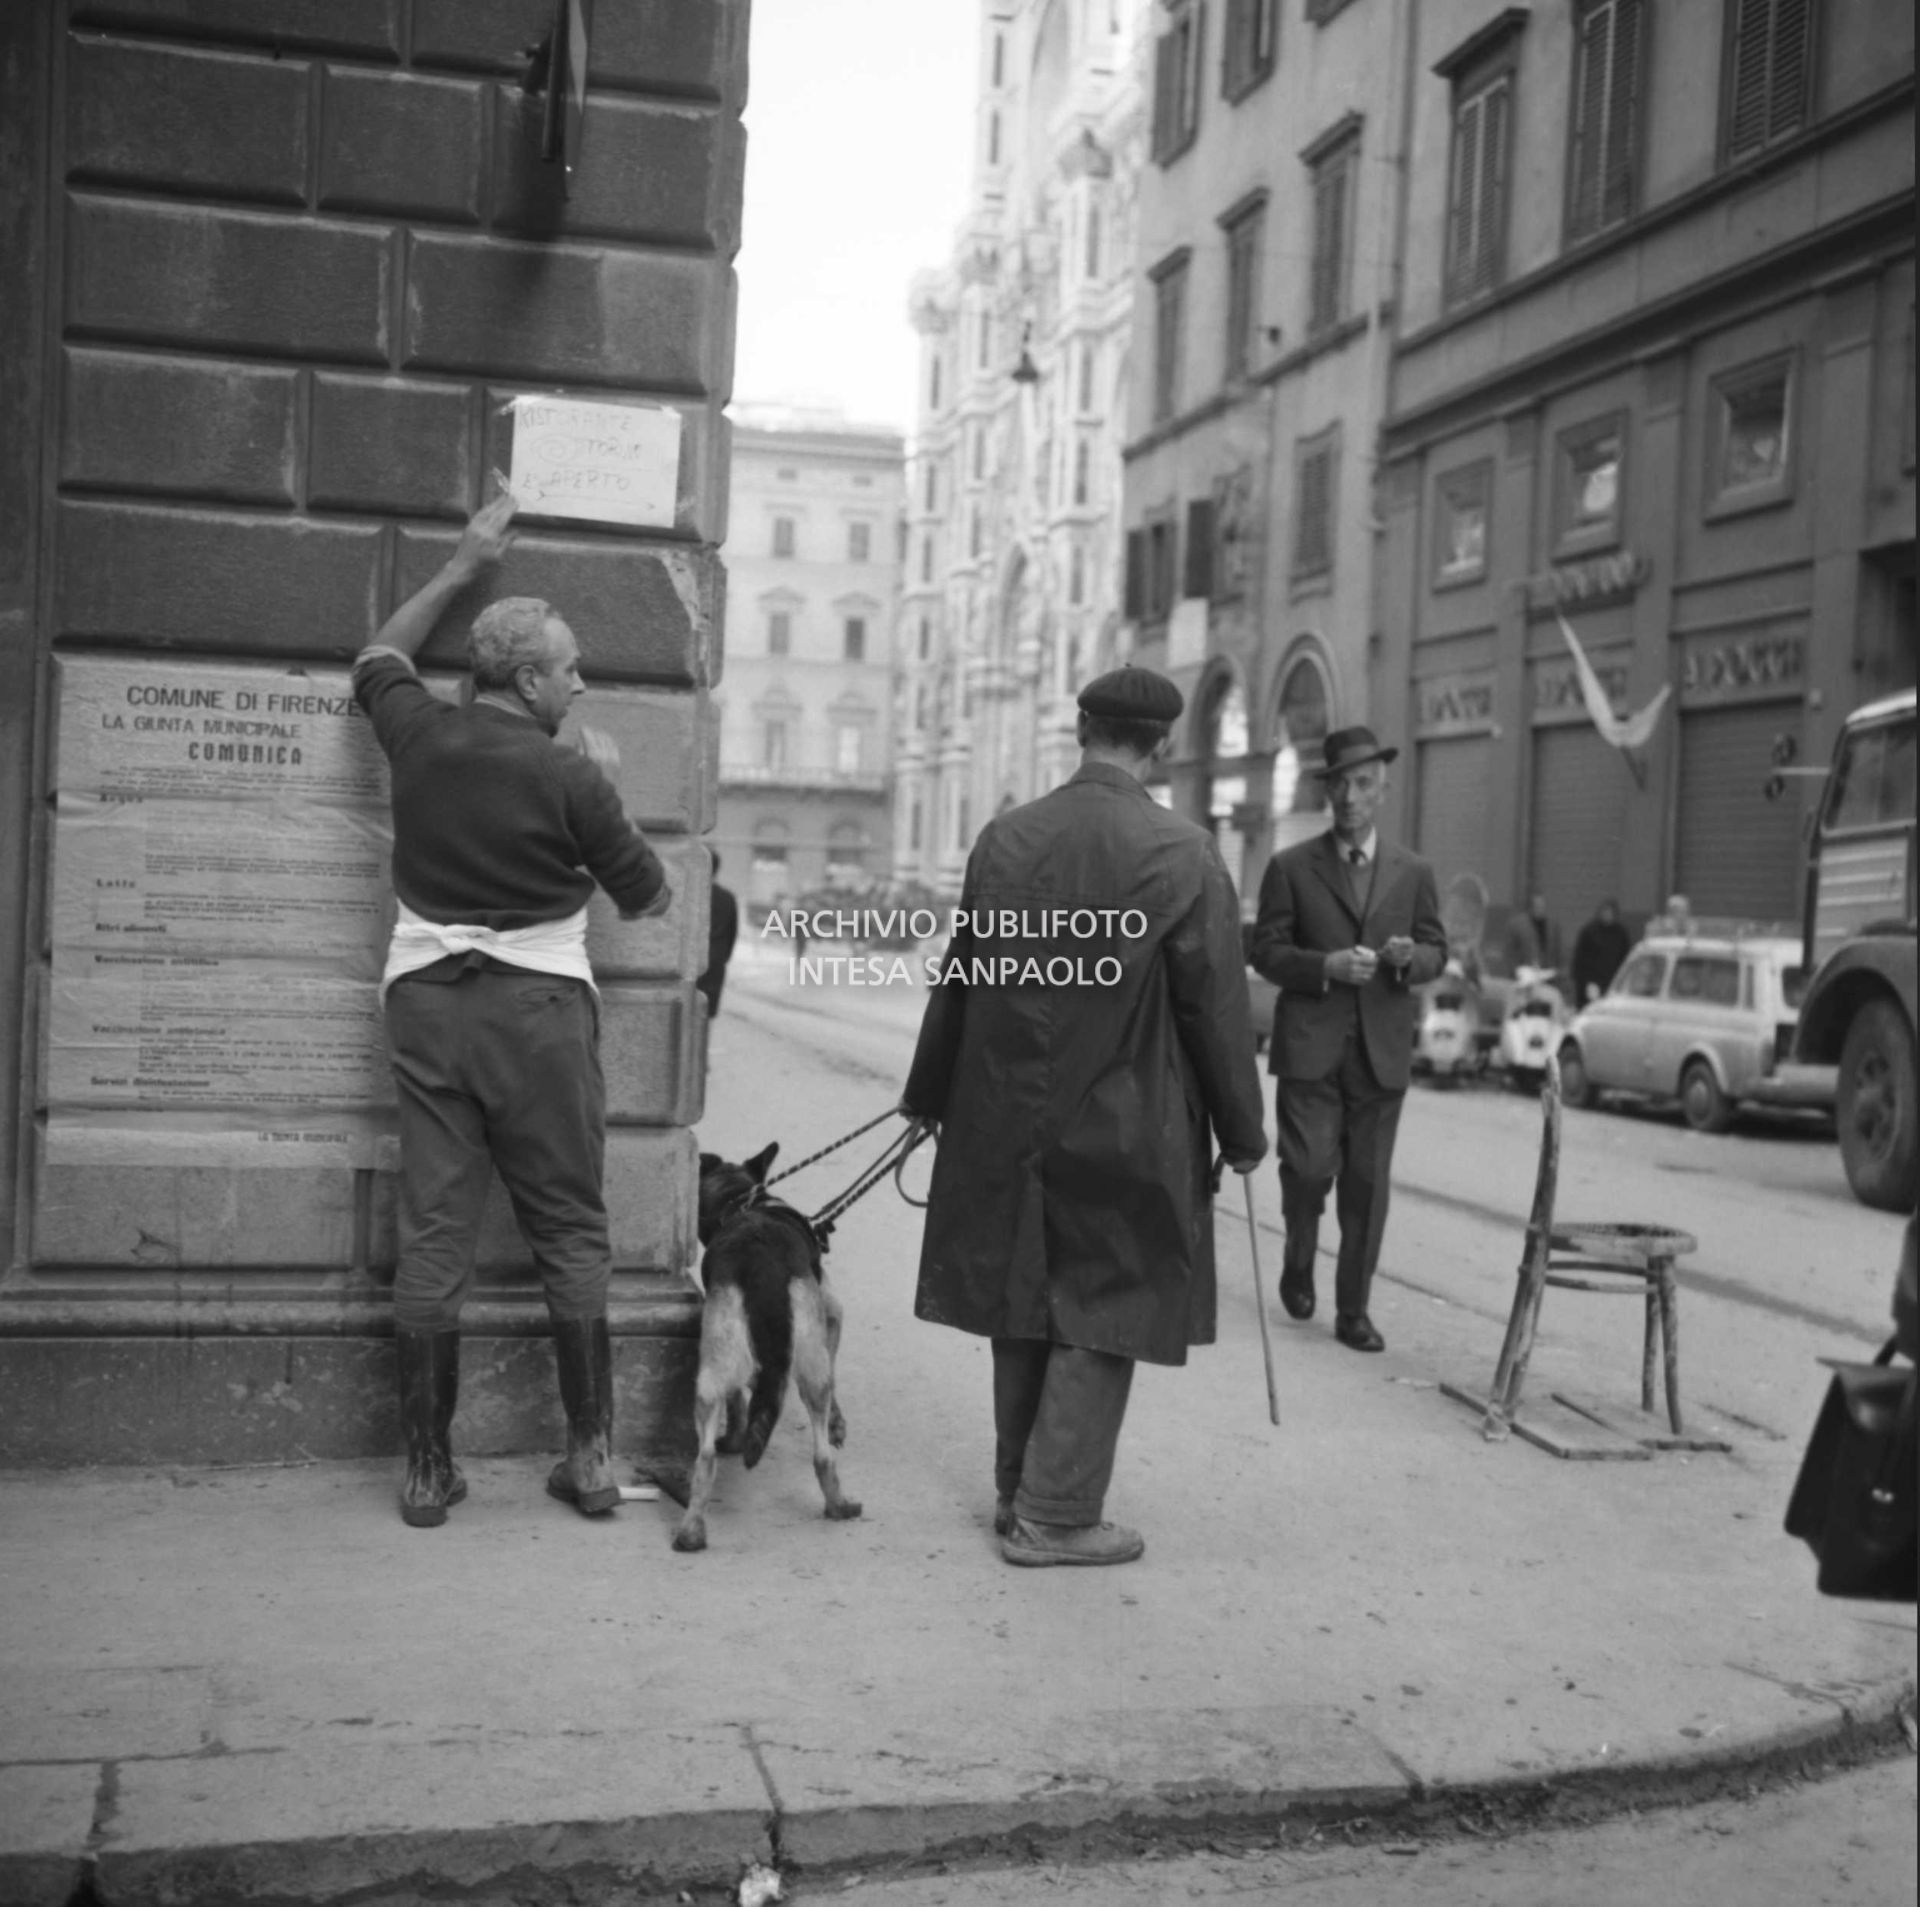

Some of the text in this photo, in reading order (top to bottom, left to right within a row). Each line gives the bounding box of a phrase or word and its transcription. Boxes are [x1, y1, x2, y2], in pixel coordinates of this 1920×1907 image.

[127, 685, 362, 717] COMUNE DI FIRENZE
[102, 714, 303, 740] LA GIUNTA MUNICIPALE
[188, 741, 303, 765] COMUNICA
